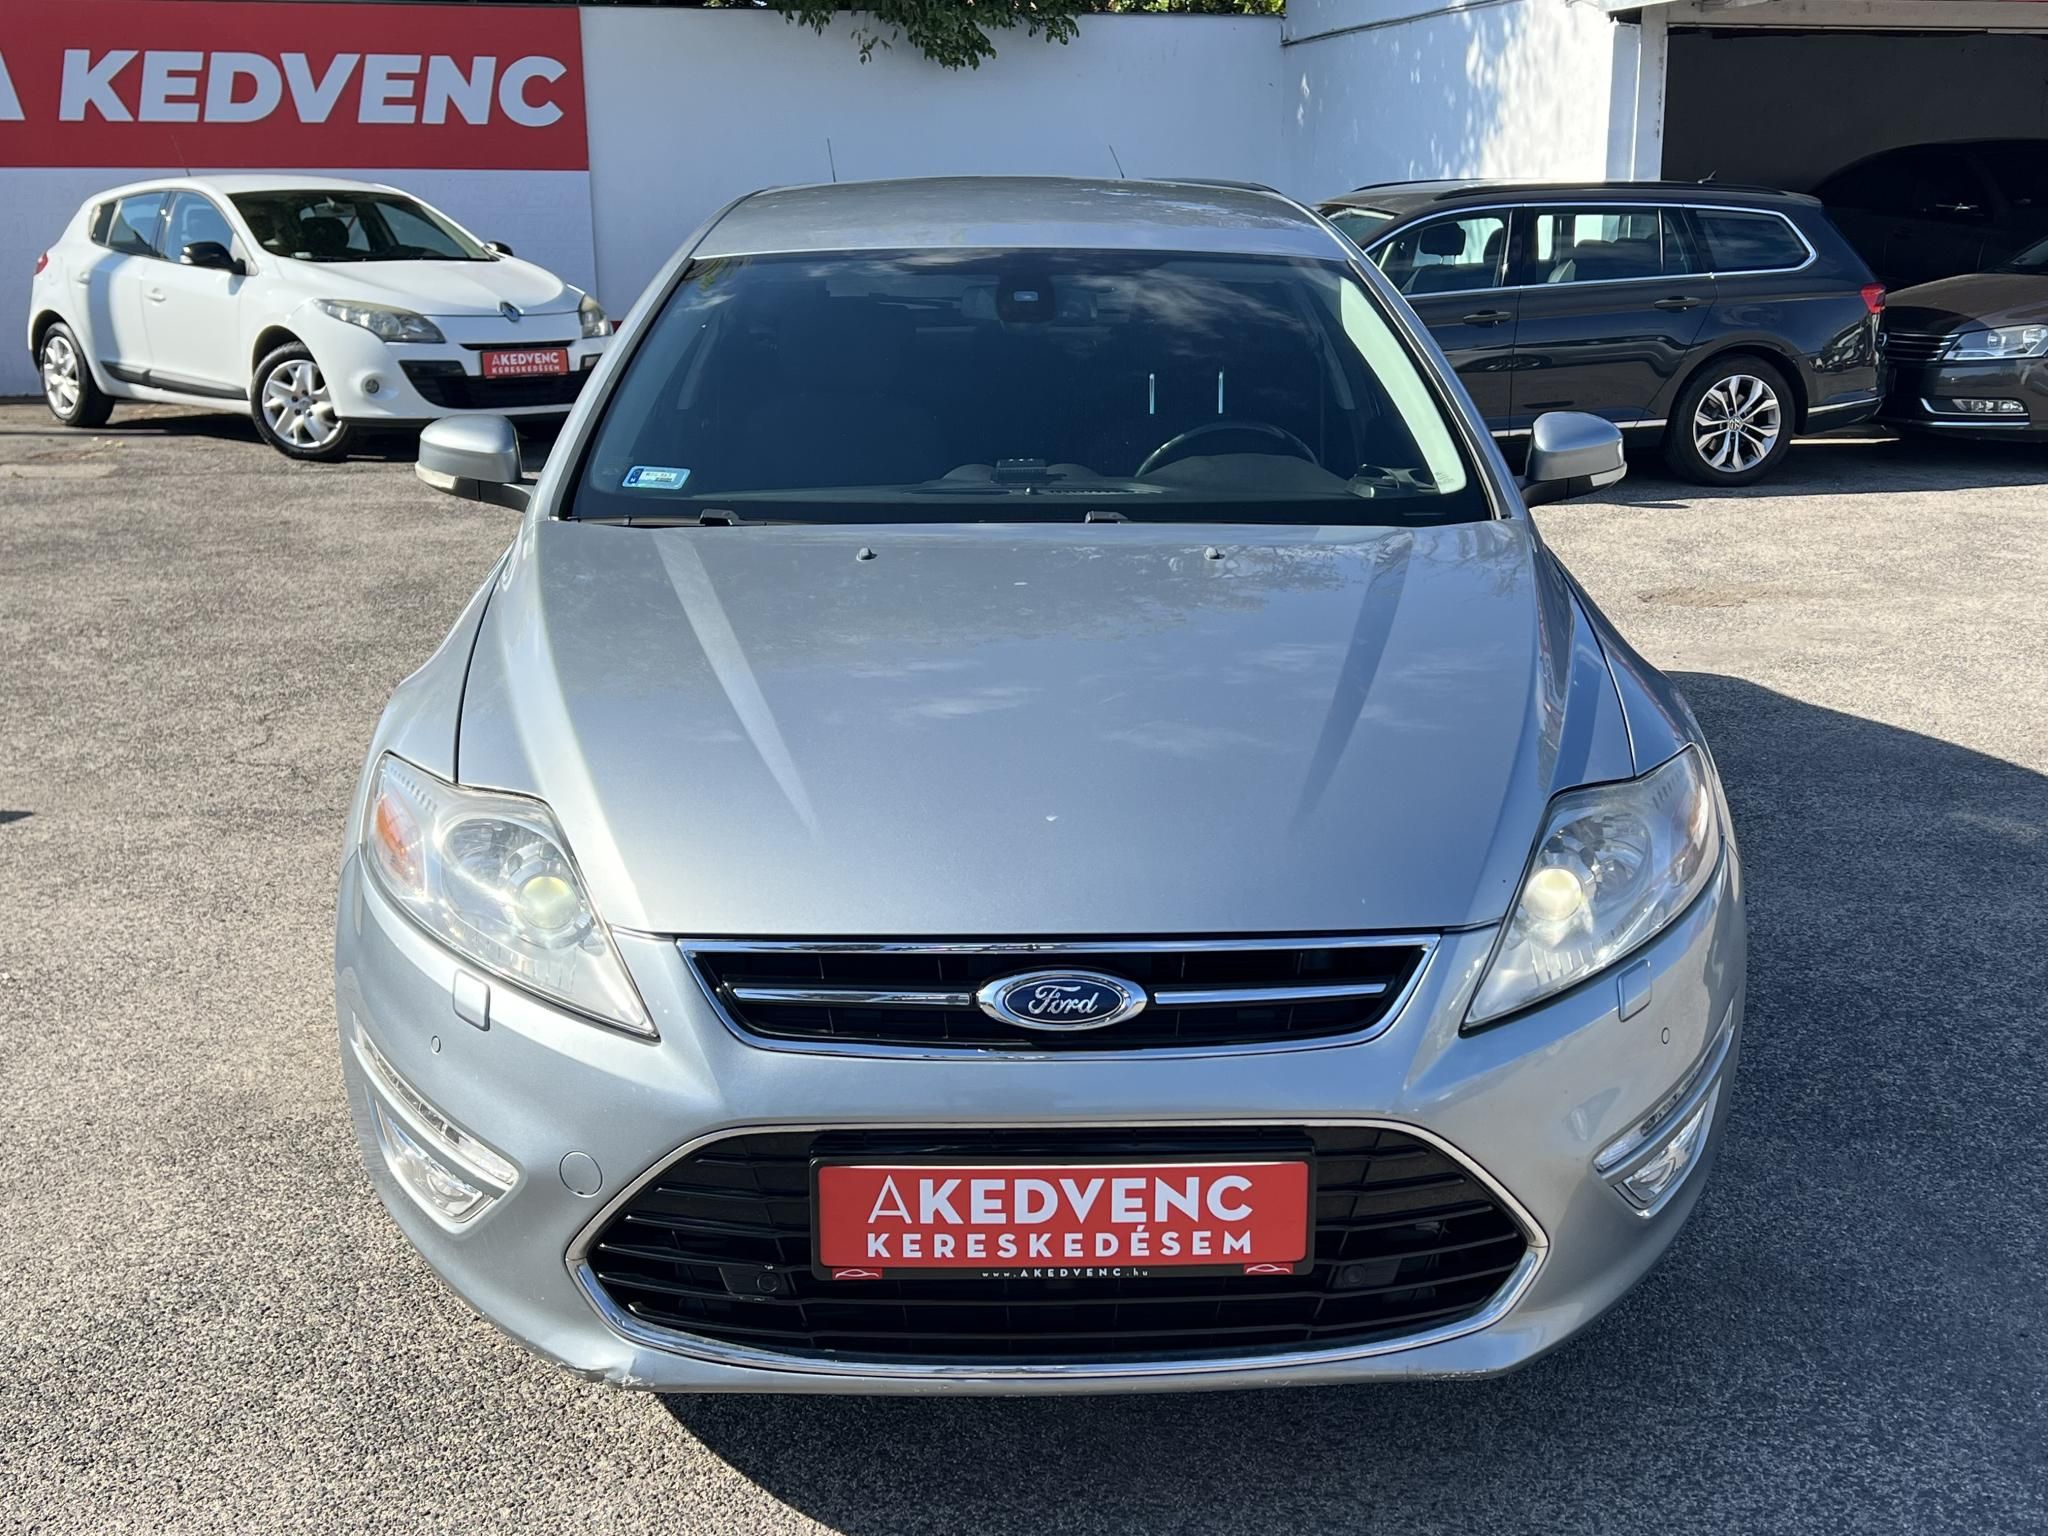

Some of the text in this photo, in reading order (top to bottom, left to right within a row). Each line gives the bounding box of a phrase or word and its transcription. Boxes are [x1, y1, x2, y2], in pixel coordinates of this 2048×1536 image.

[59, 49, 567, 127] KEDVENC
[492, 352, 560, 366] AKEDVENC
[1028, 985, 1099, 1014] Ford
[867, 1174, 1253, 1224] AKEDVENC
[867, 1225, 1252, 1258] KERESKEDÉSEM
[982, 1268, 1149, 1277] www.AKEDVENC.hu
